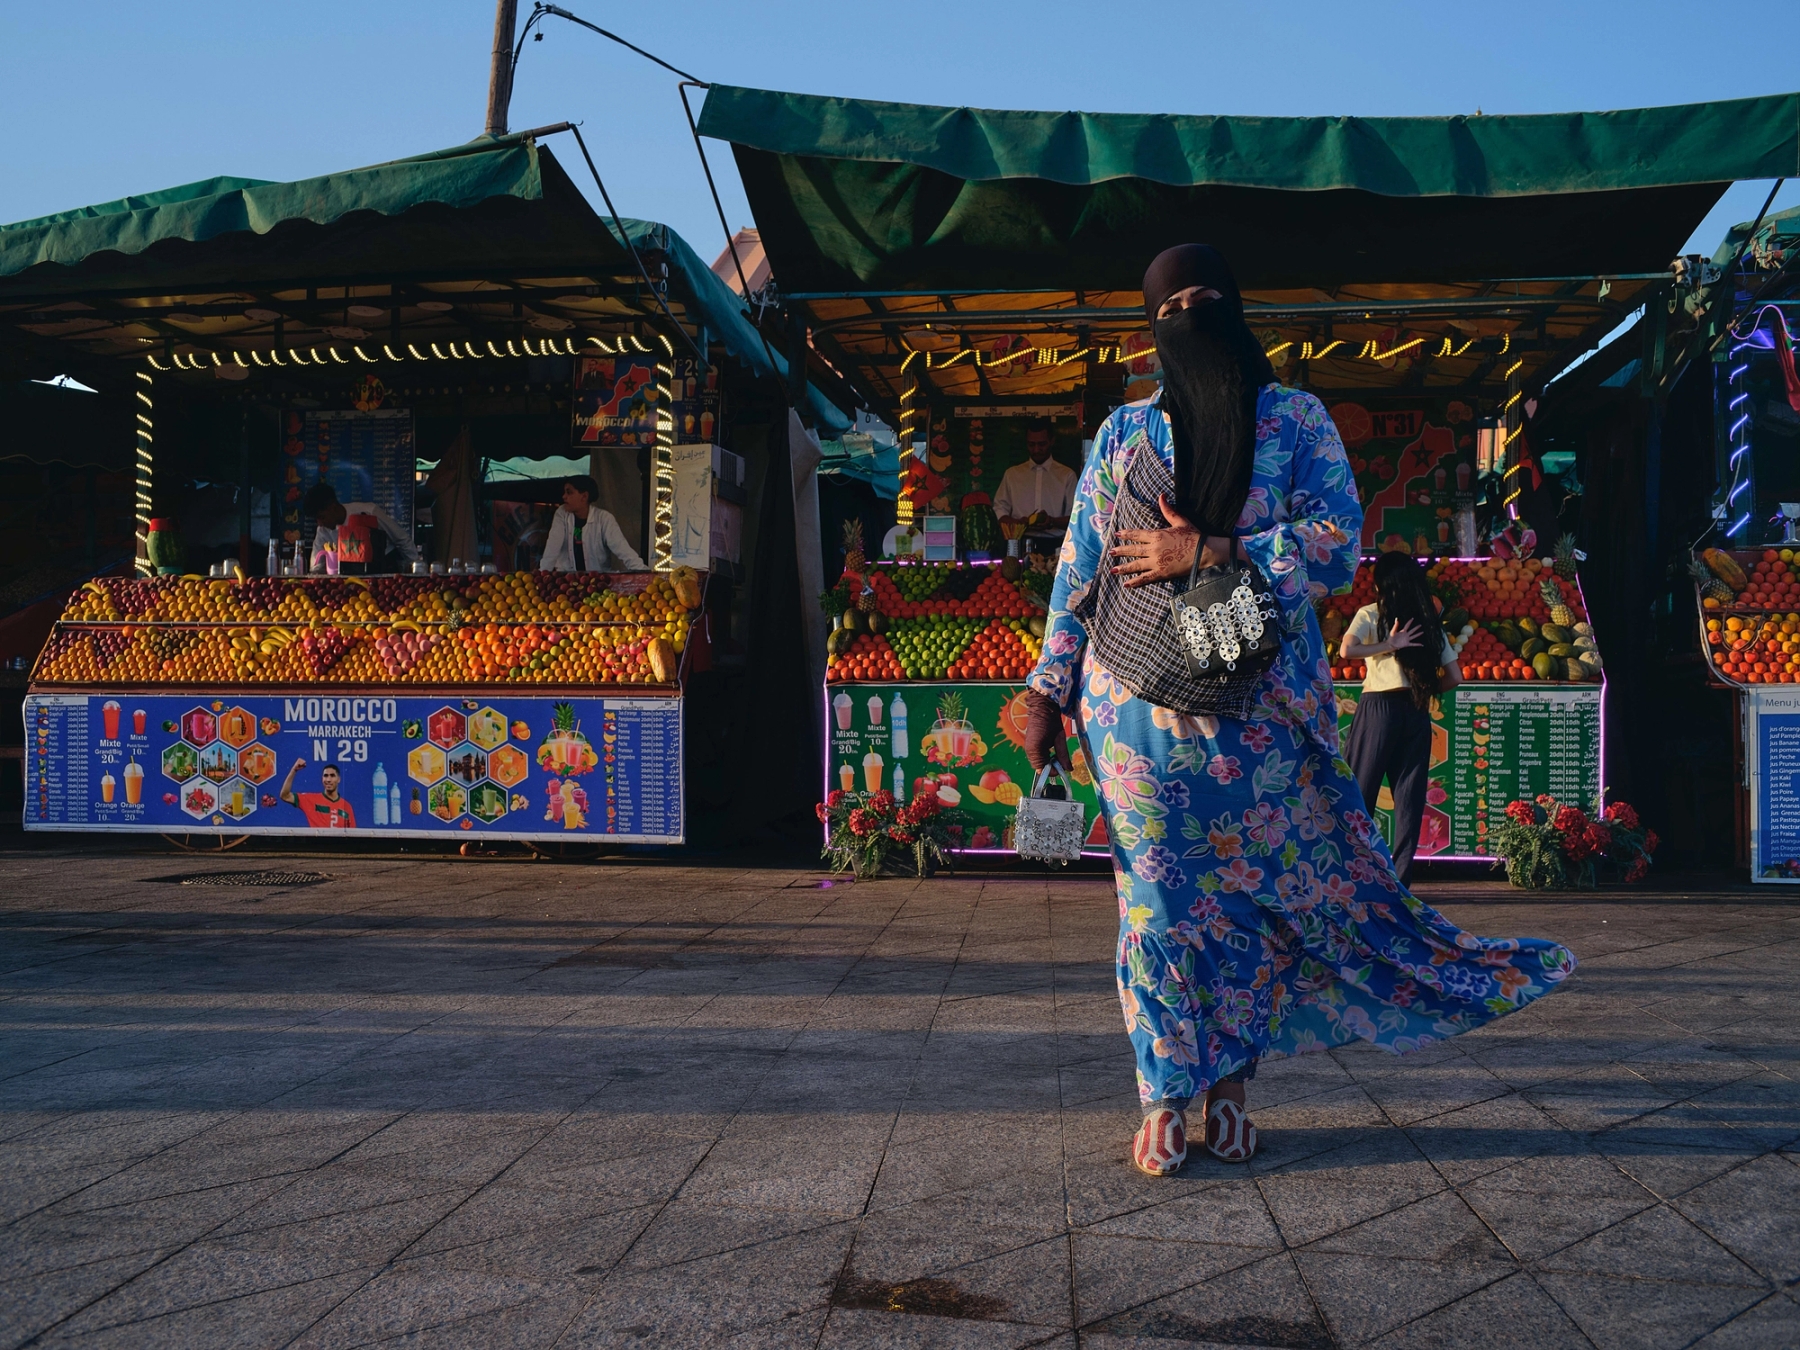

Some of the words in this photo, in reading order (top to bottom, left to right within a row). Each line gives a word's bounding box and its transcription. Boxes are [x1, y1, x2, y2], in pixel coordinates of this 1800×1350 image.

[576, 416, 631, 427] MOROCCO
[1372, 412, 1415, 438] N°31
[1765, 698, 1793, 708] Menu
[284, 698, 397, 724] MOROCCO
[892, 719, 907, 727] 10dh
[308, 725, 372, 739] MARRAKECH
[130, 733, 148, 741] Mixte
[100, 739, 121, 748] Mixte
[313, 739, 328, 762] N
[337, 739, 369, 763] 29
[1519, 759, 1542, 767] Gingembre
[120, 802, 145, 810] Orange
[1455, 798, 1470, 806] Papaya
